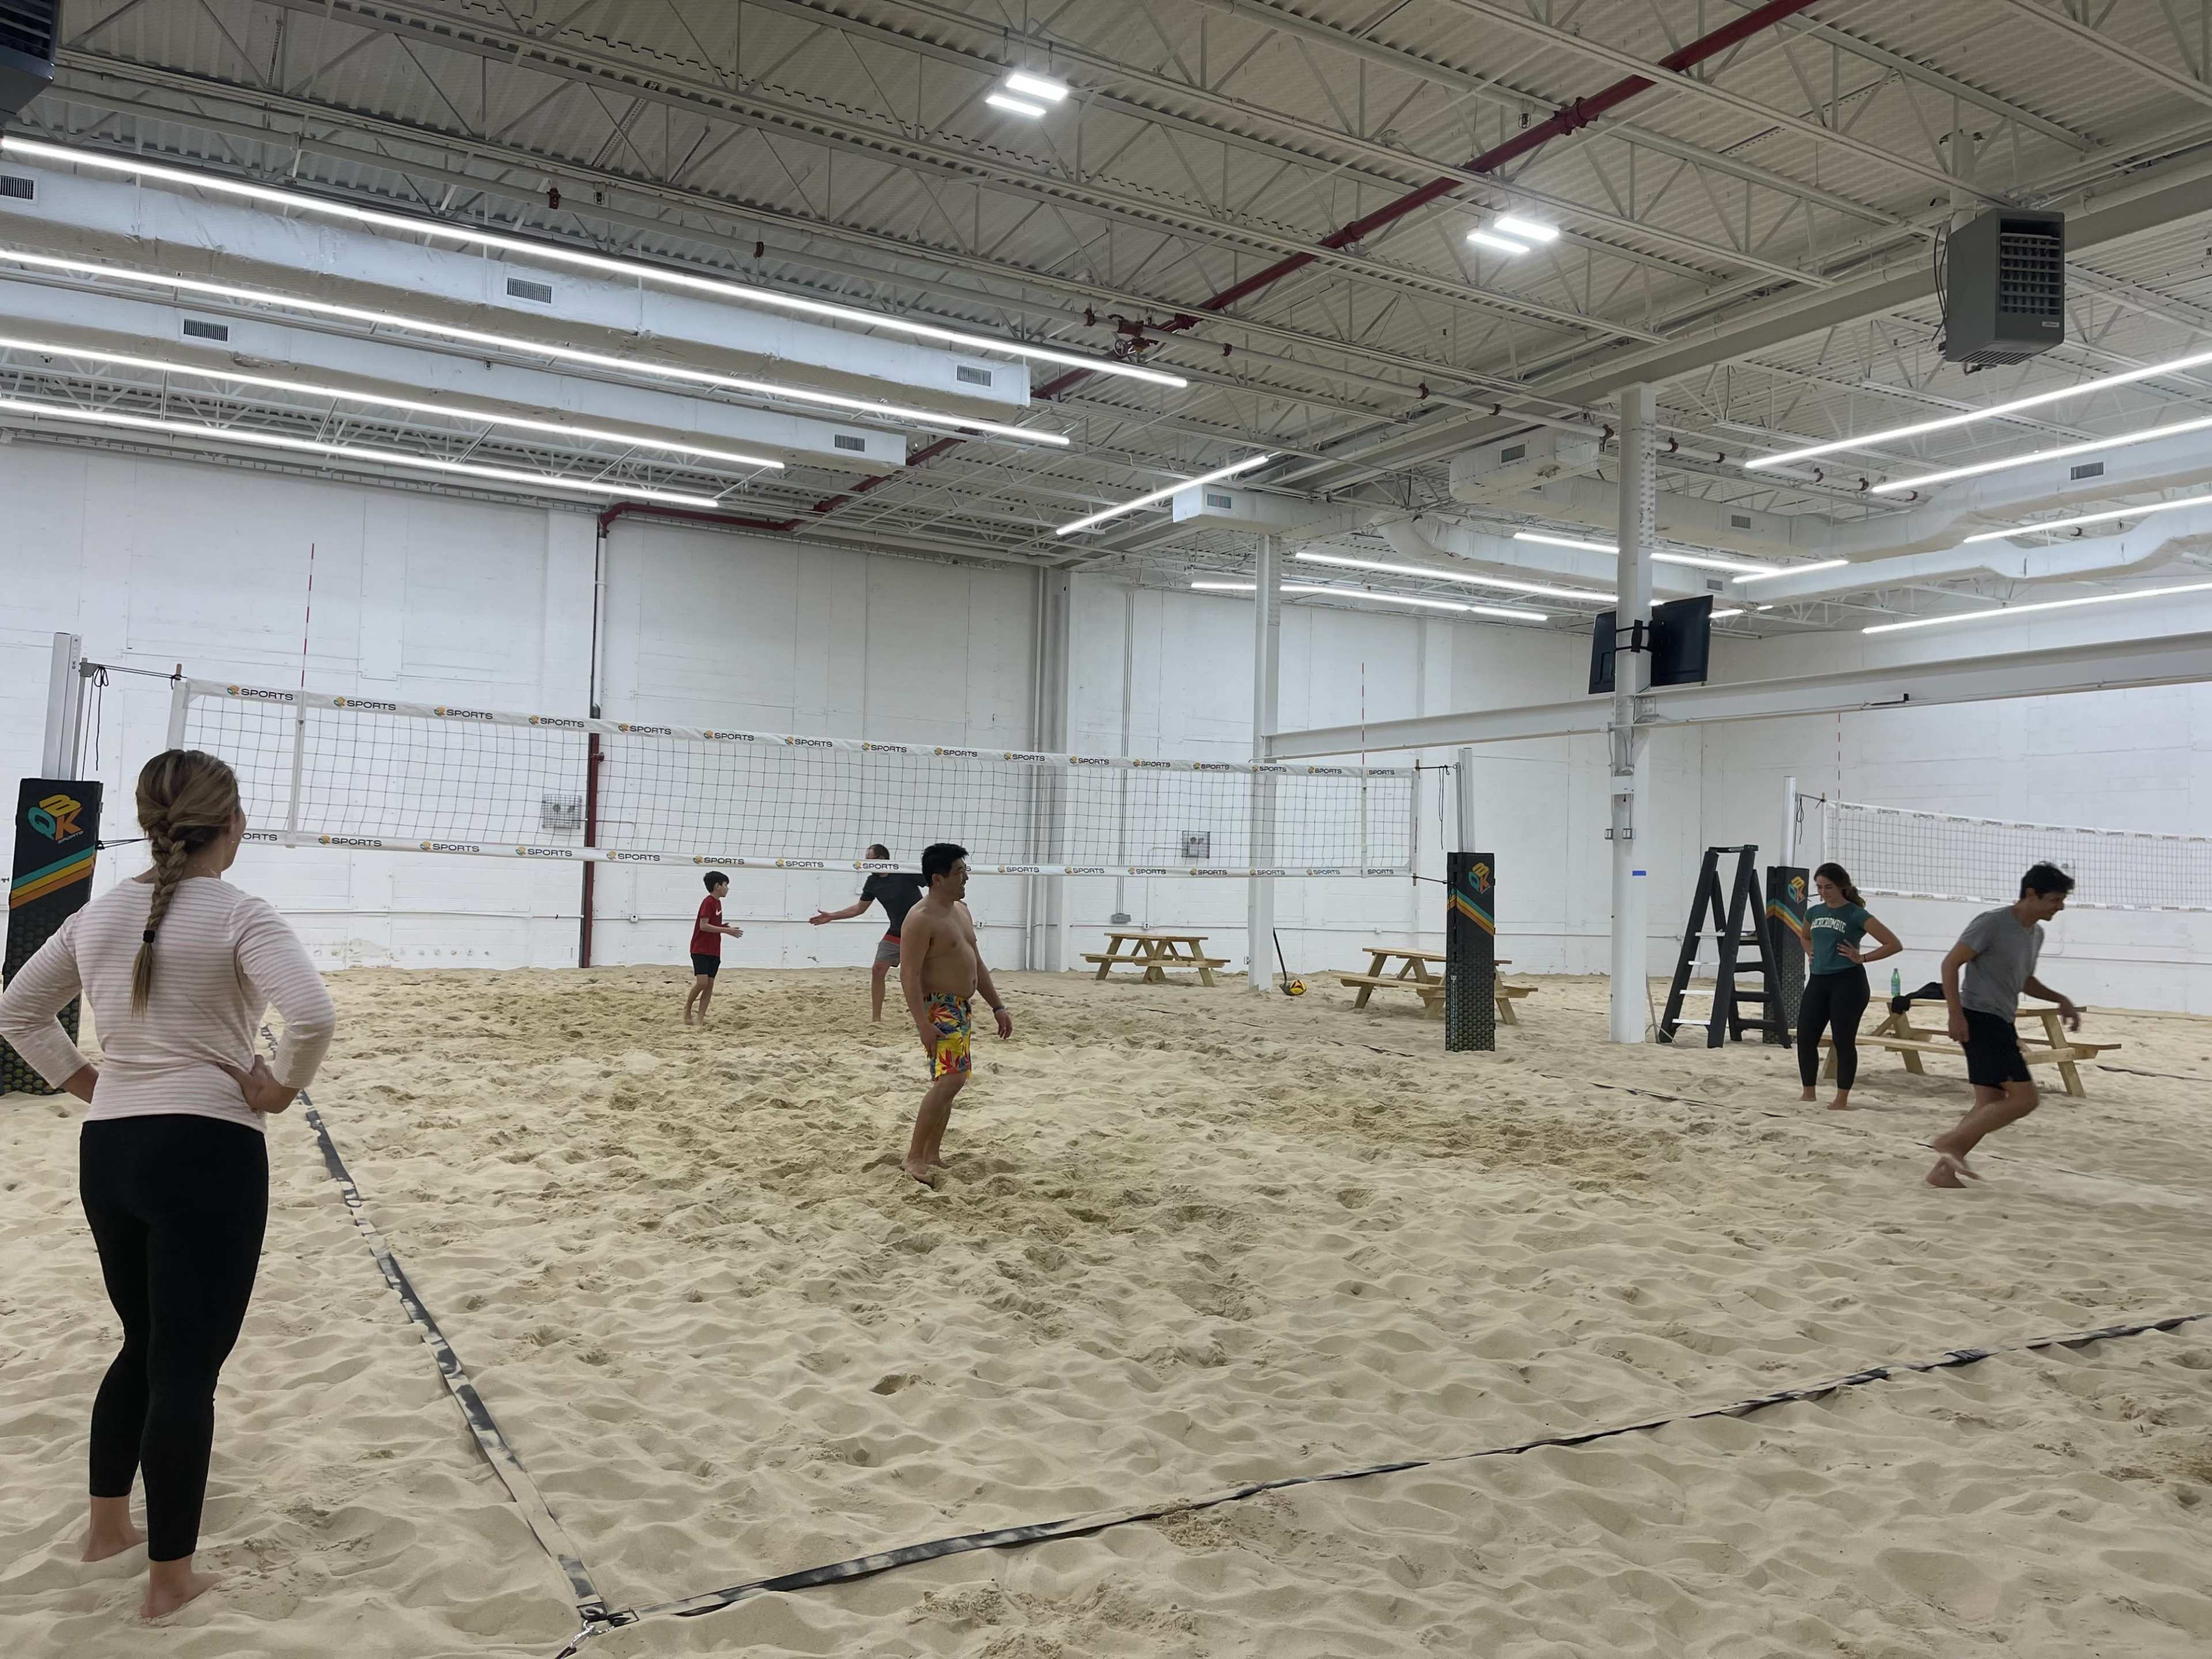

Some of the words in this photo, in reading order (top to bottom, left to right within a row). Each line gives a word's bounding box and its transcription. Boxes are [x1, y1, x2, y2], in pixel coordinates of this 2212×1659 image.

[241, 689, 293, 700] SPORTS
[347, 700, 396, 710] SPORTS
[446, 710, 493, 719] SPORTS
[540, 718, 584, 728] SPORTS
[630, 726, 671, 734] SPORTS
[714, 733, 754, 741] SPORTS
[795, 739, 832, 747] SPORTS
[243, 833, 278, 841] ORTS
[332, 838, 381, 847] SPORTS
[433, 844, 479, 852] SPORTS
[527, 849, 572, 857] SPORTS
[618, 854, 660, 862] SPORTS
